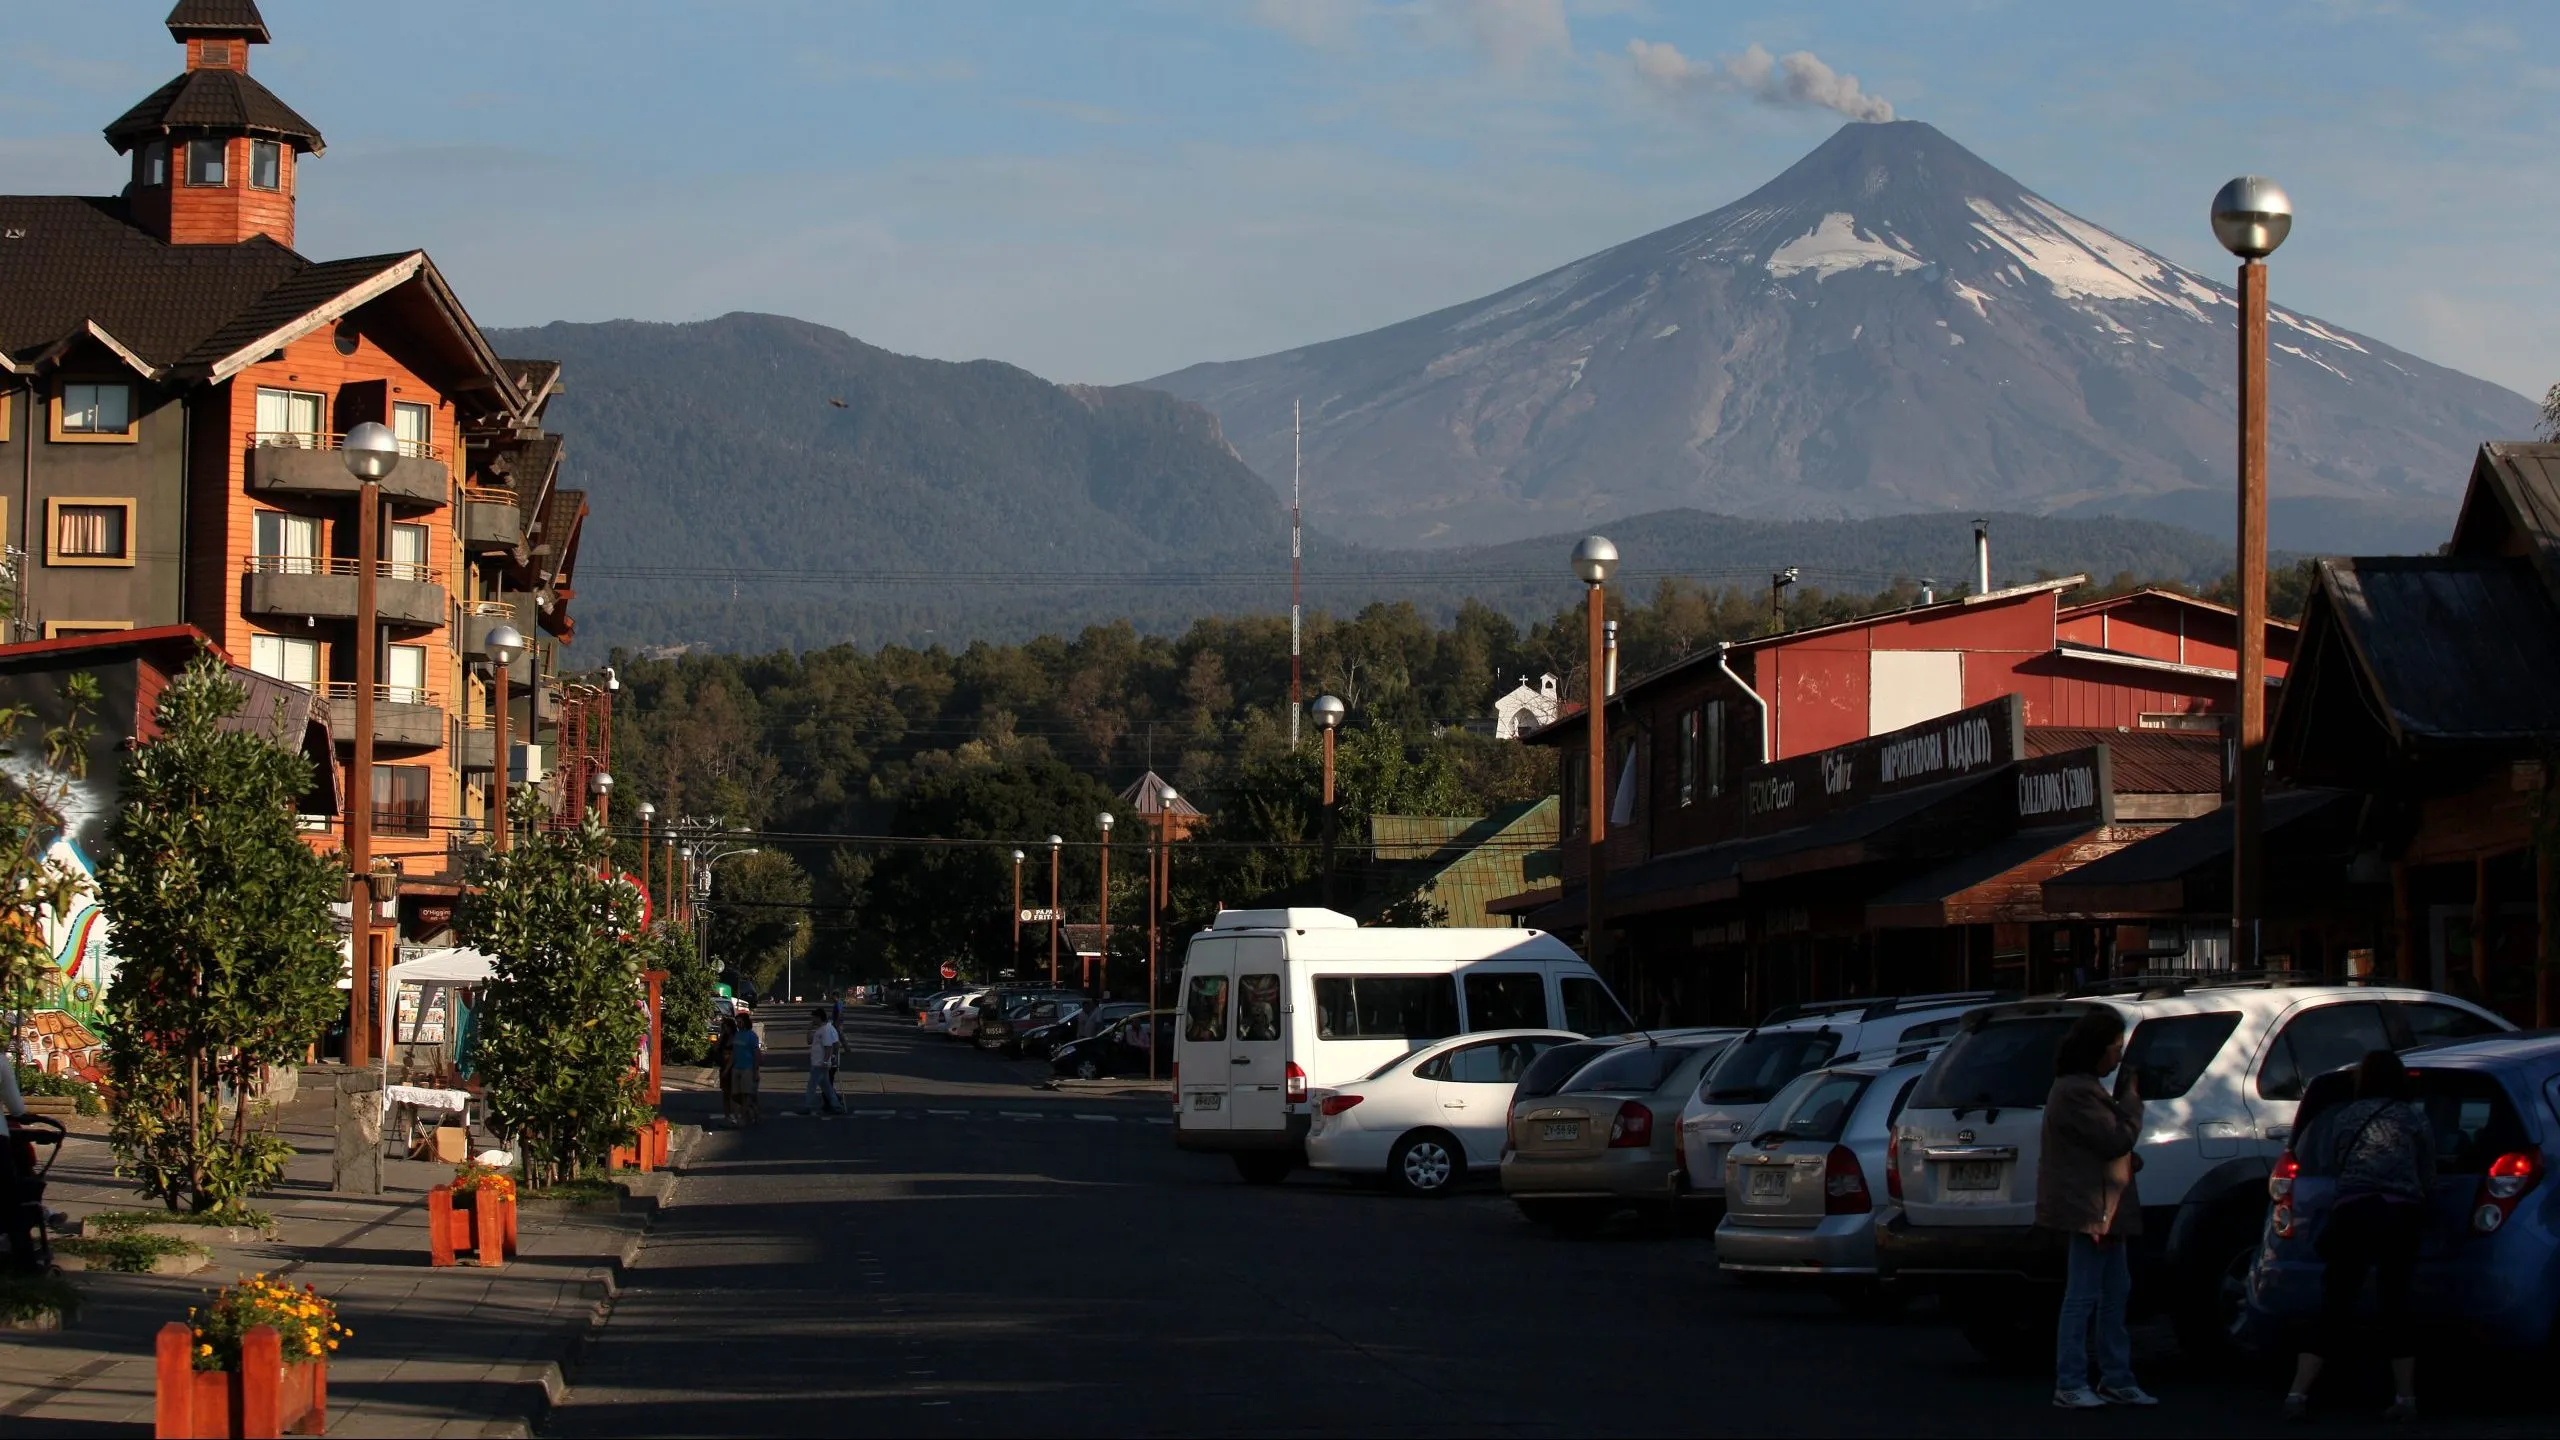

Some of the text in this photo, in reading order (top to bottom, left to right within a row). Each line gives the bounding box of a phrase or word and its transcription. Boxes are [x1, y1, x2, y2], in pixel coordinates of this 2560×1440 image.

[1881, 717, 1992, 783] IMPORTADORA KARIM
[2019, 766, 2094, 816] CALZADOS CEDRO
